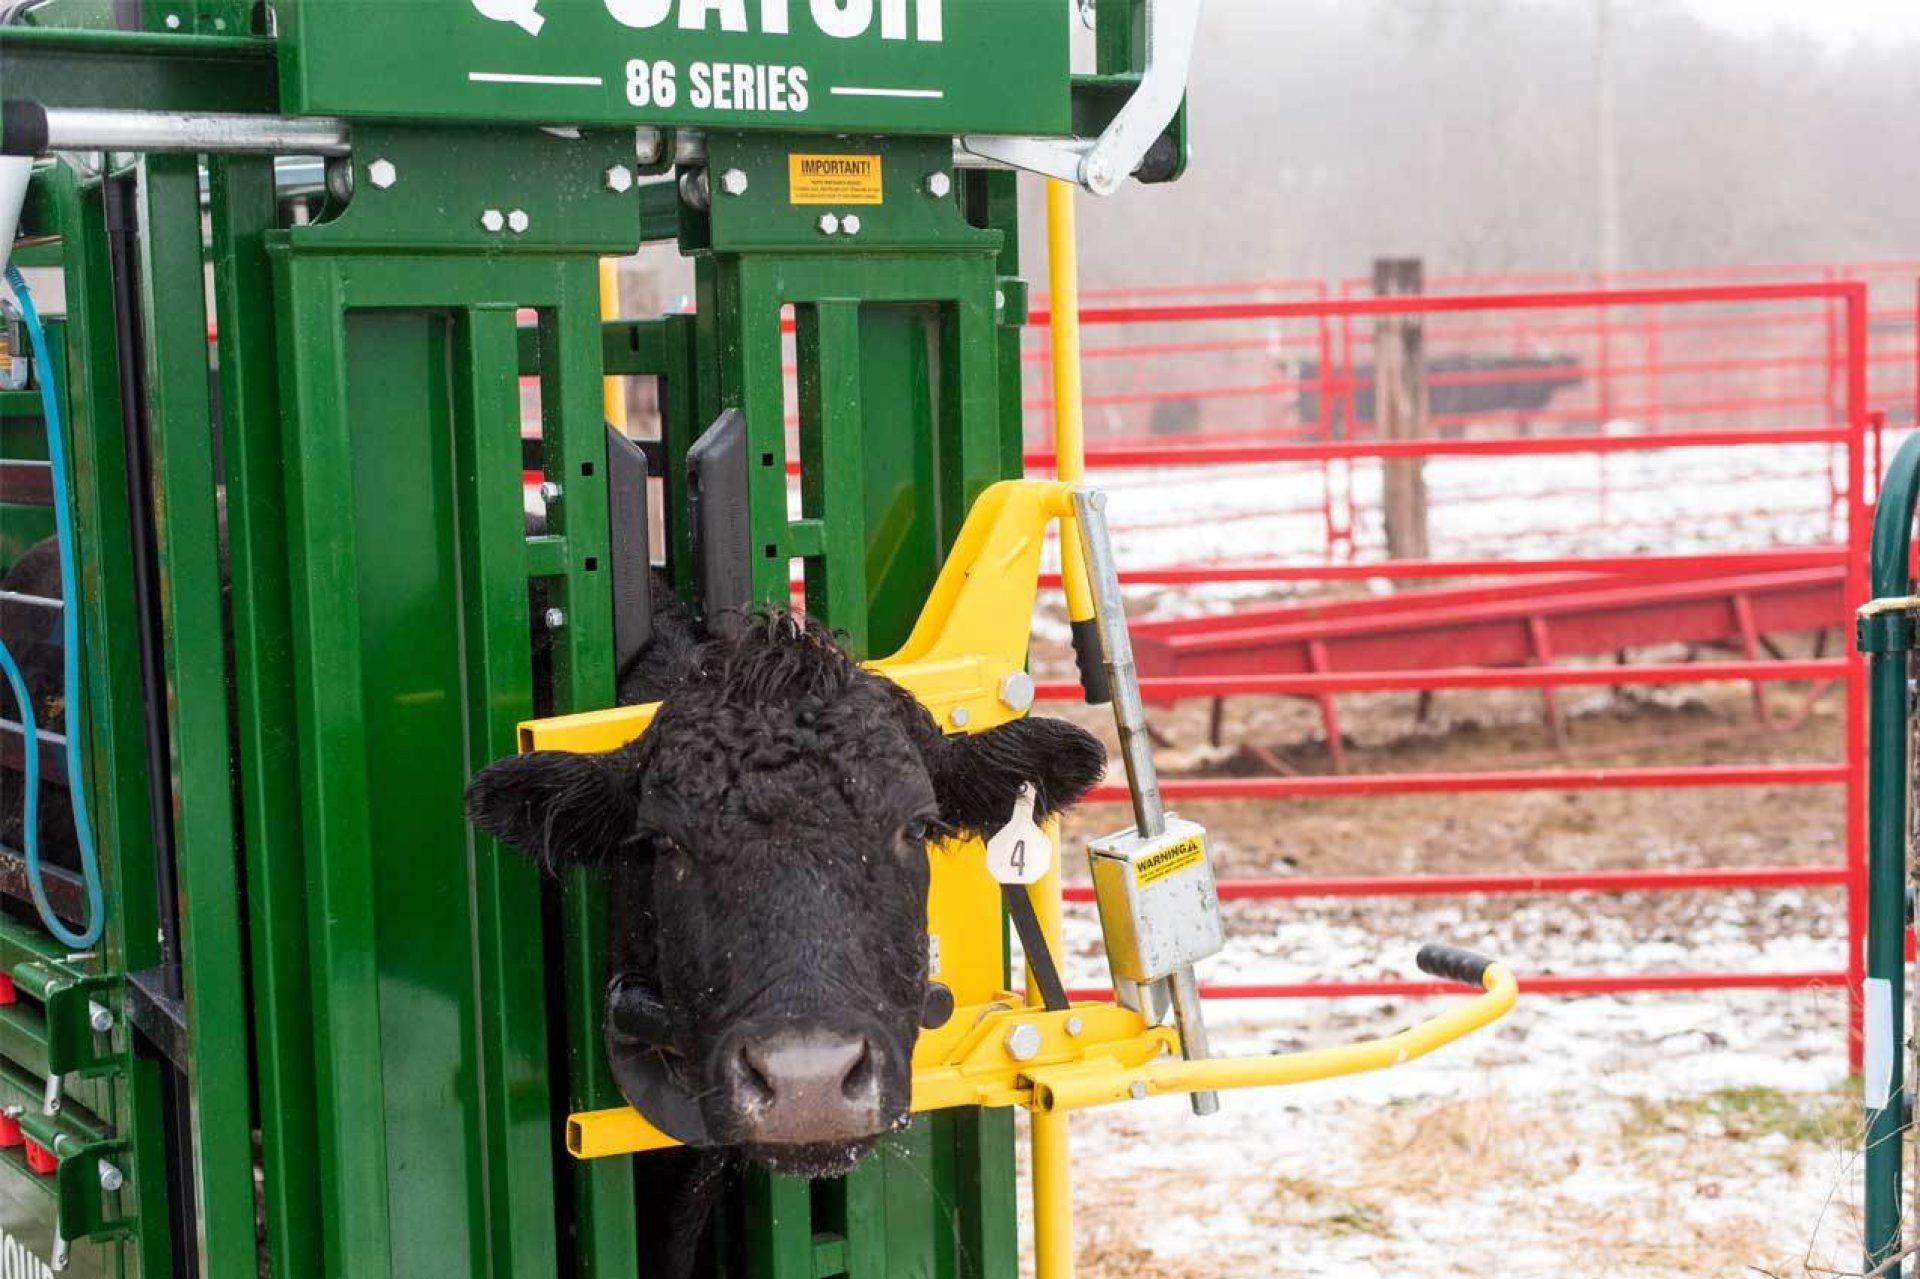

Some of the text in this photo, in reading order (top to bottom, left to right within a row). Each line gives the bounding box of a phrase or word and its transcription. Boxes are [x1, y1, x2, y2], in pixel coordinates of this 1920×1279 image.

[625, 59, 808, 111] 86 SERIES
[801, 160, 870, 174] IMPORTANT!
[1010, 838, 1025, 877] 4
[1136, 844, 1187, 872] WARNING
